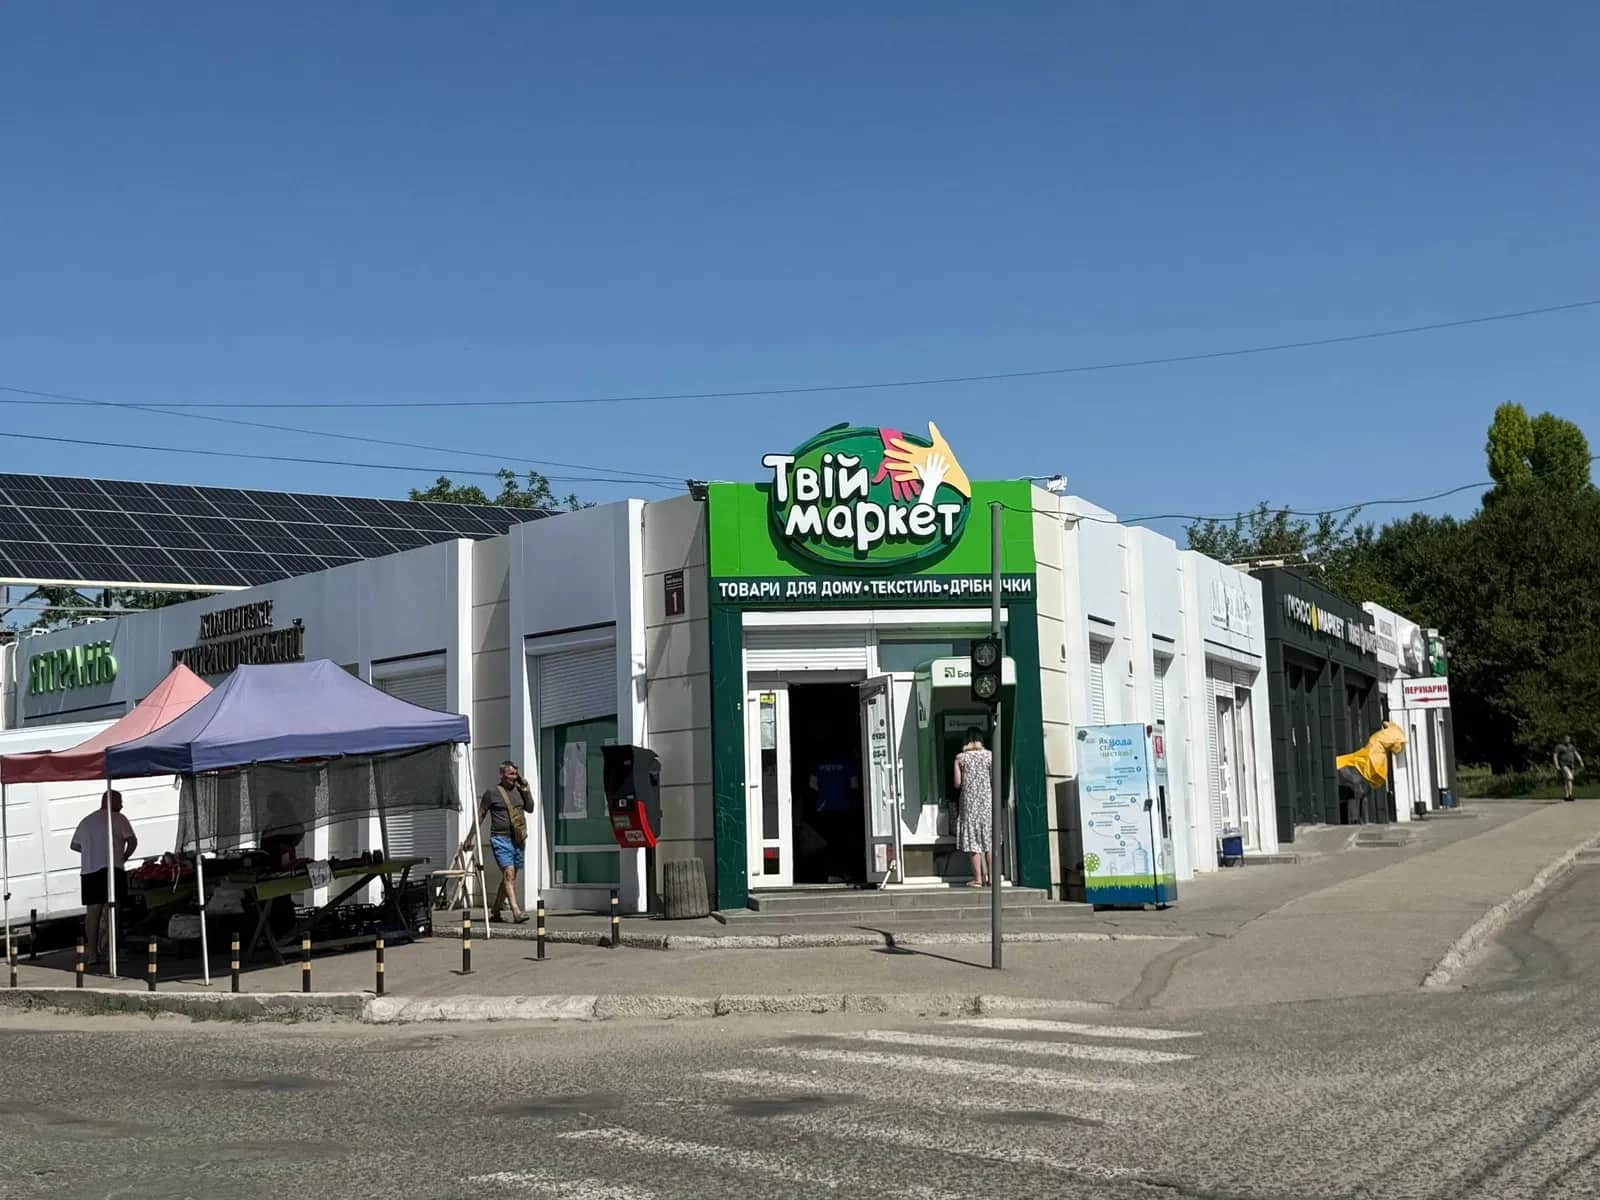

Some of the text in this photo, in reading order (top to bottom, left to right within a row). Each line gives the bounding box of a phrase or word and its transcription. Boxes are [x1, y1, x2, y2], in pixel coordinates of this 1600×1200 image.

[762, 453, 870, 503] Твій
[785, 501, 961, 551] маркет
[671, 591, 678, 613] 1
[719, 581, 780, 597] ТОВАРИ
[786, 581, 817, 597] ДЛЯ
[821, 580, 862, 597] ДОМУ
[870, 579, 942, 595] ТЕКСТИЛЬ
[29, 640, 118, 696] ЯТРАНЬ
